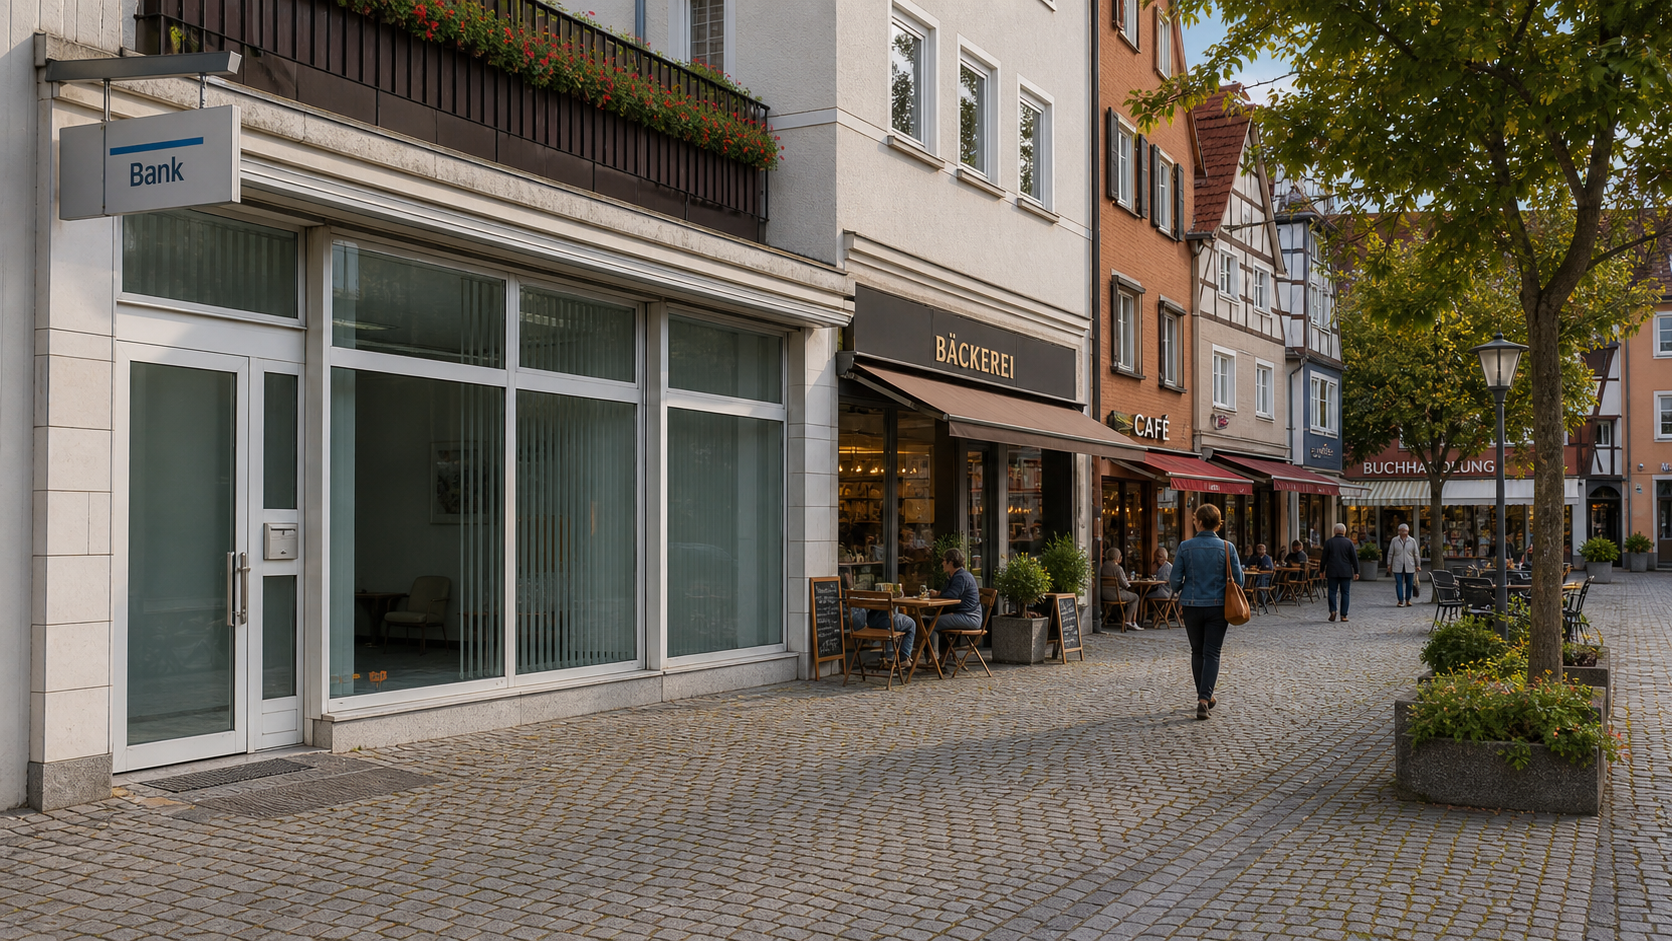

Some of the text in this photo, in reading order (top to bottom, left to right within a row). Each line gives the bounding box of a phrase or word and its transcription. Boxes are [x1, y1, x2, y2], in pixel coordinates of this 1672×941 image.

[130, 156, 184, 187] Bank
[935, 332, 1014, 379] BÄCKEREI
[1134, 413, 1171, 441] CAFÉ
